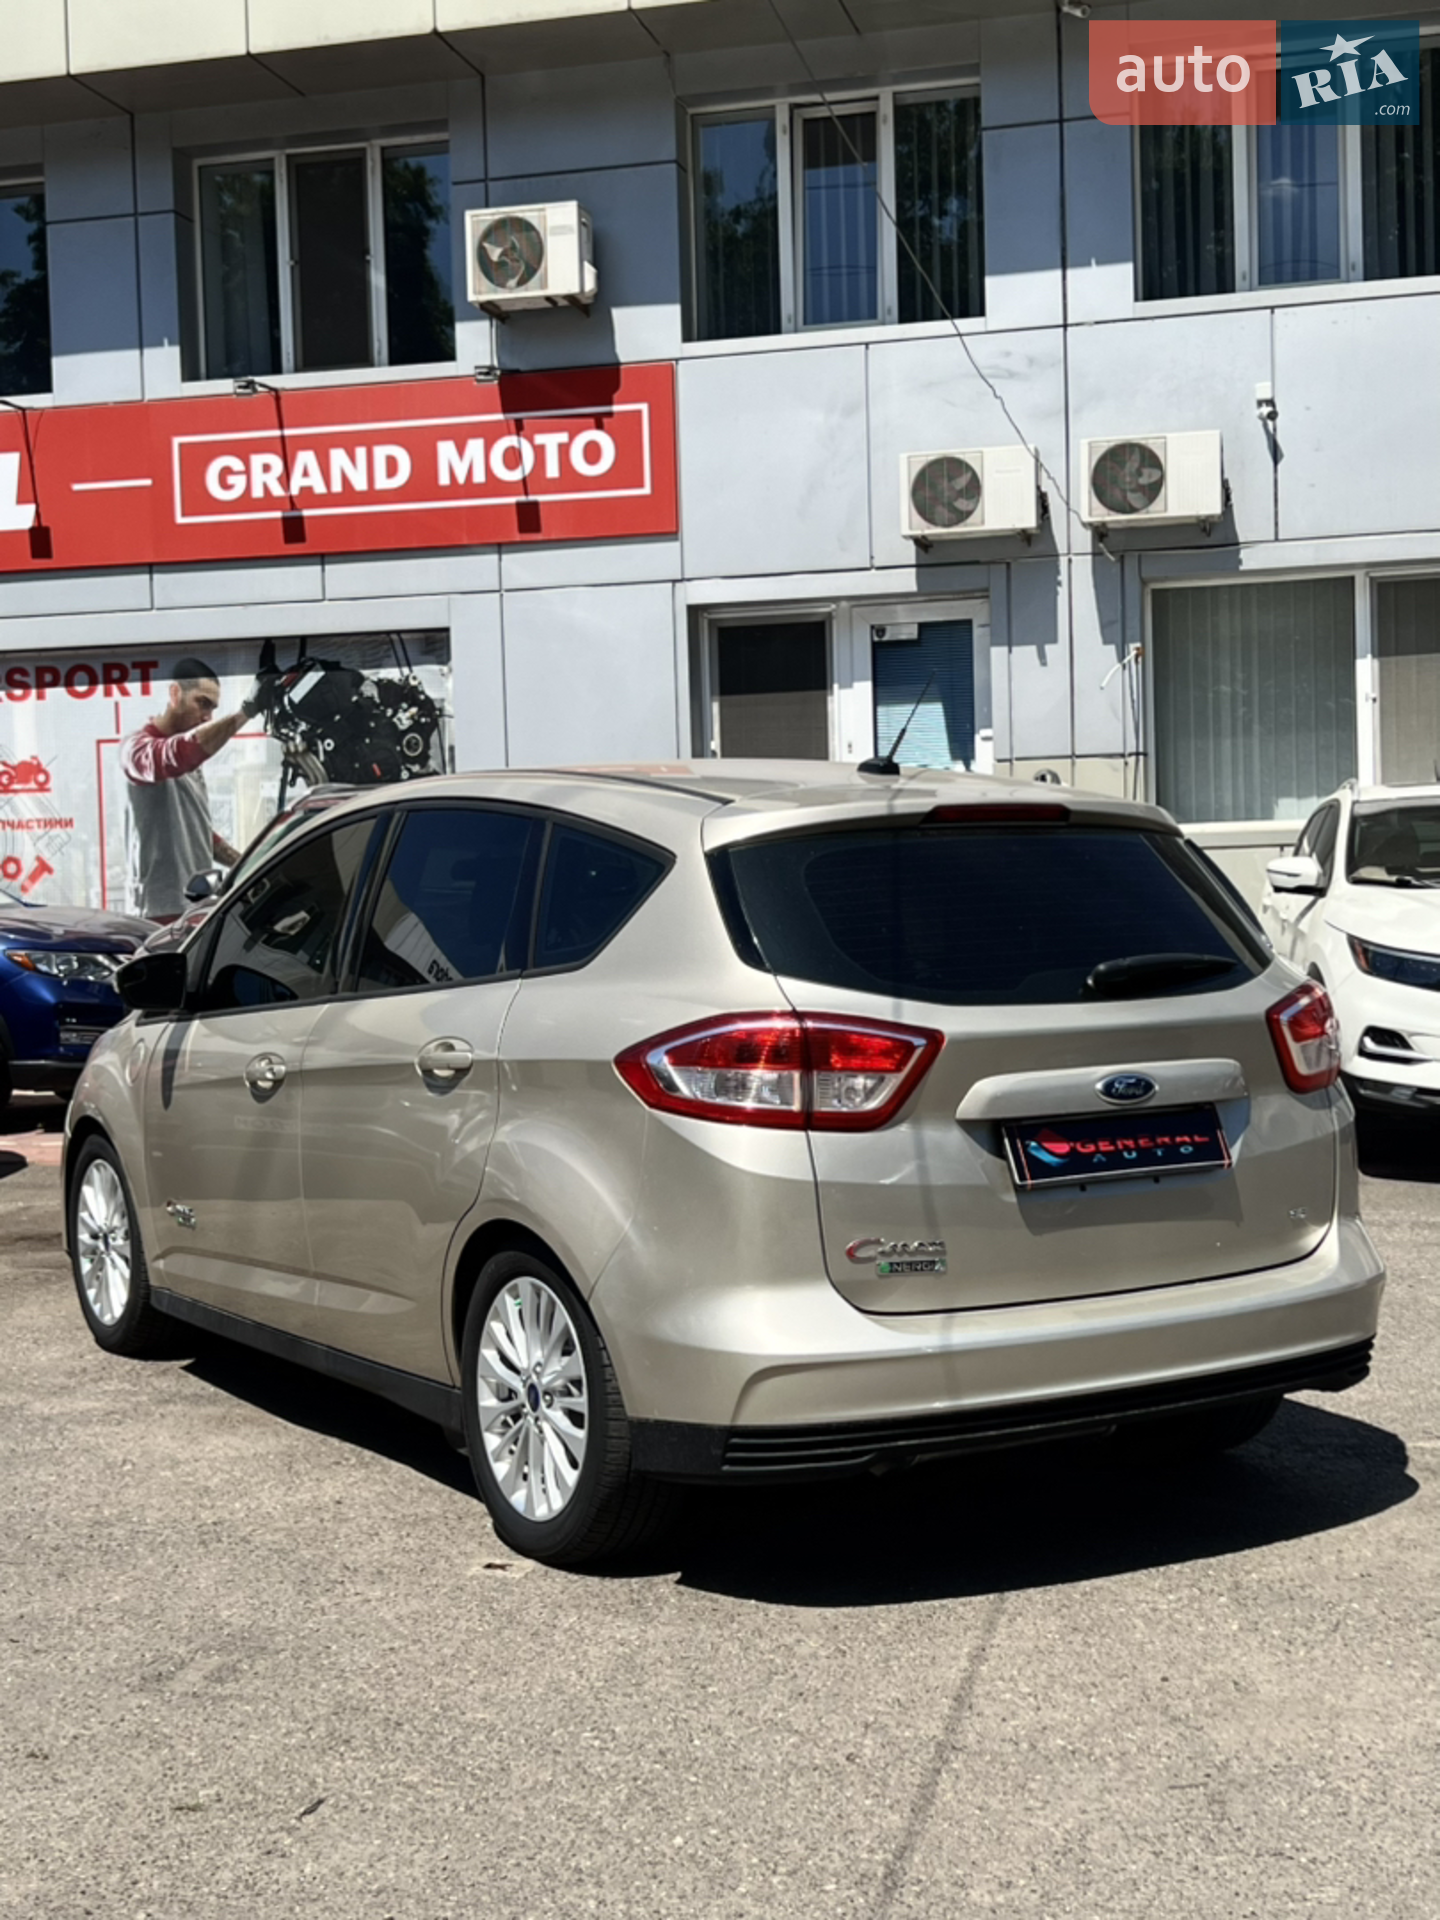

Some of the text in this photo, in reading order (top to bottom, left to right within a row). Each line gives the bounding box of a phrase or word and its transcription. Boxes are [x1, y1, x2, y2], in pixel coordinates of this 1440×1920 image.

[205, 443, 412, 501] GRAND
[436, 429, 616, 486] MOTO
[0, 660, 160, 703] SPORT
[1076, 1134, 1210, 1153] GENERAL
[1092, 1145, 1194, 1163] AUTO
